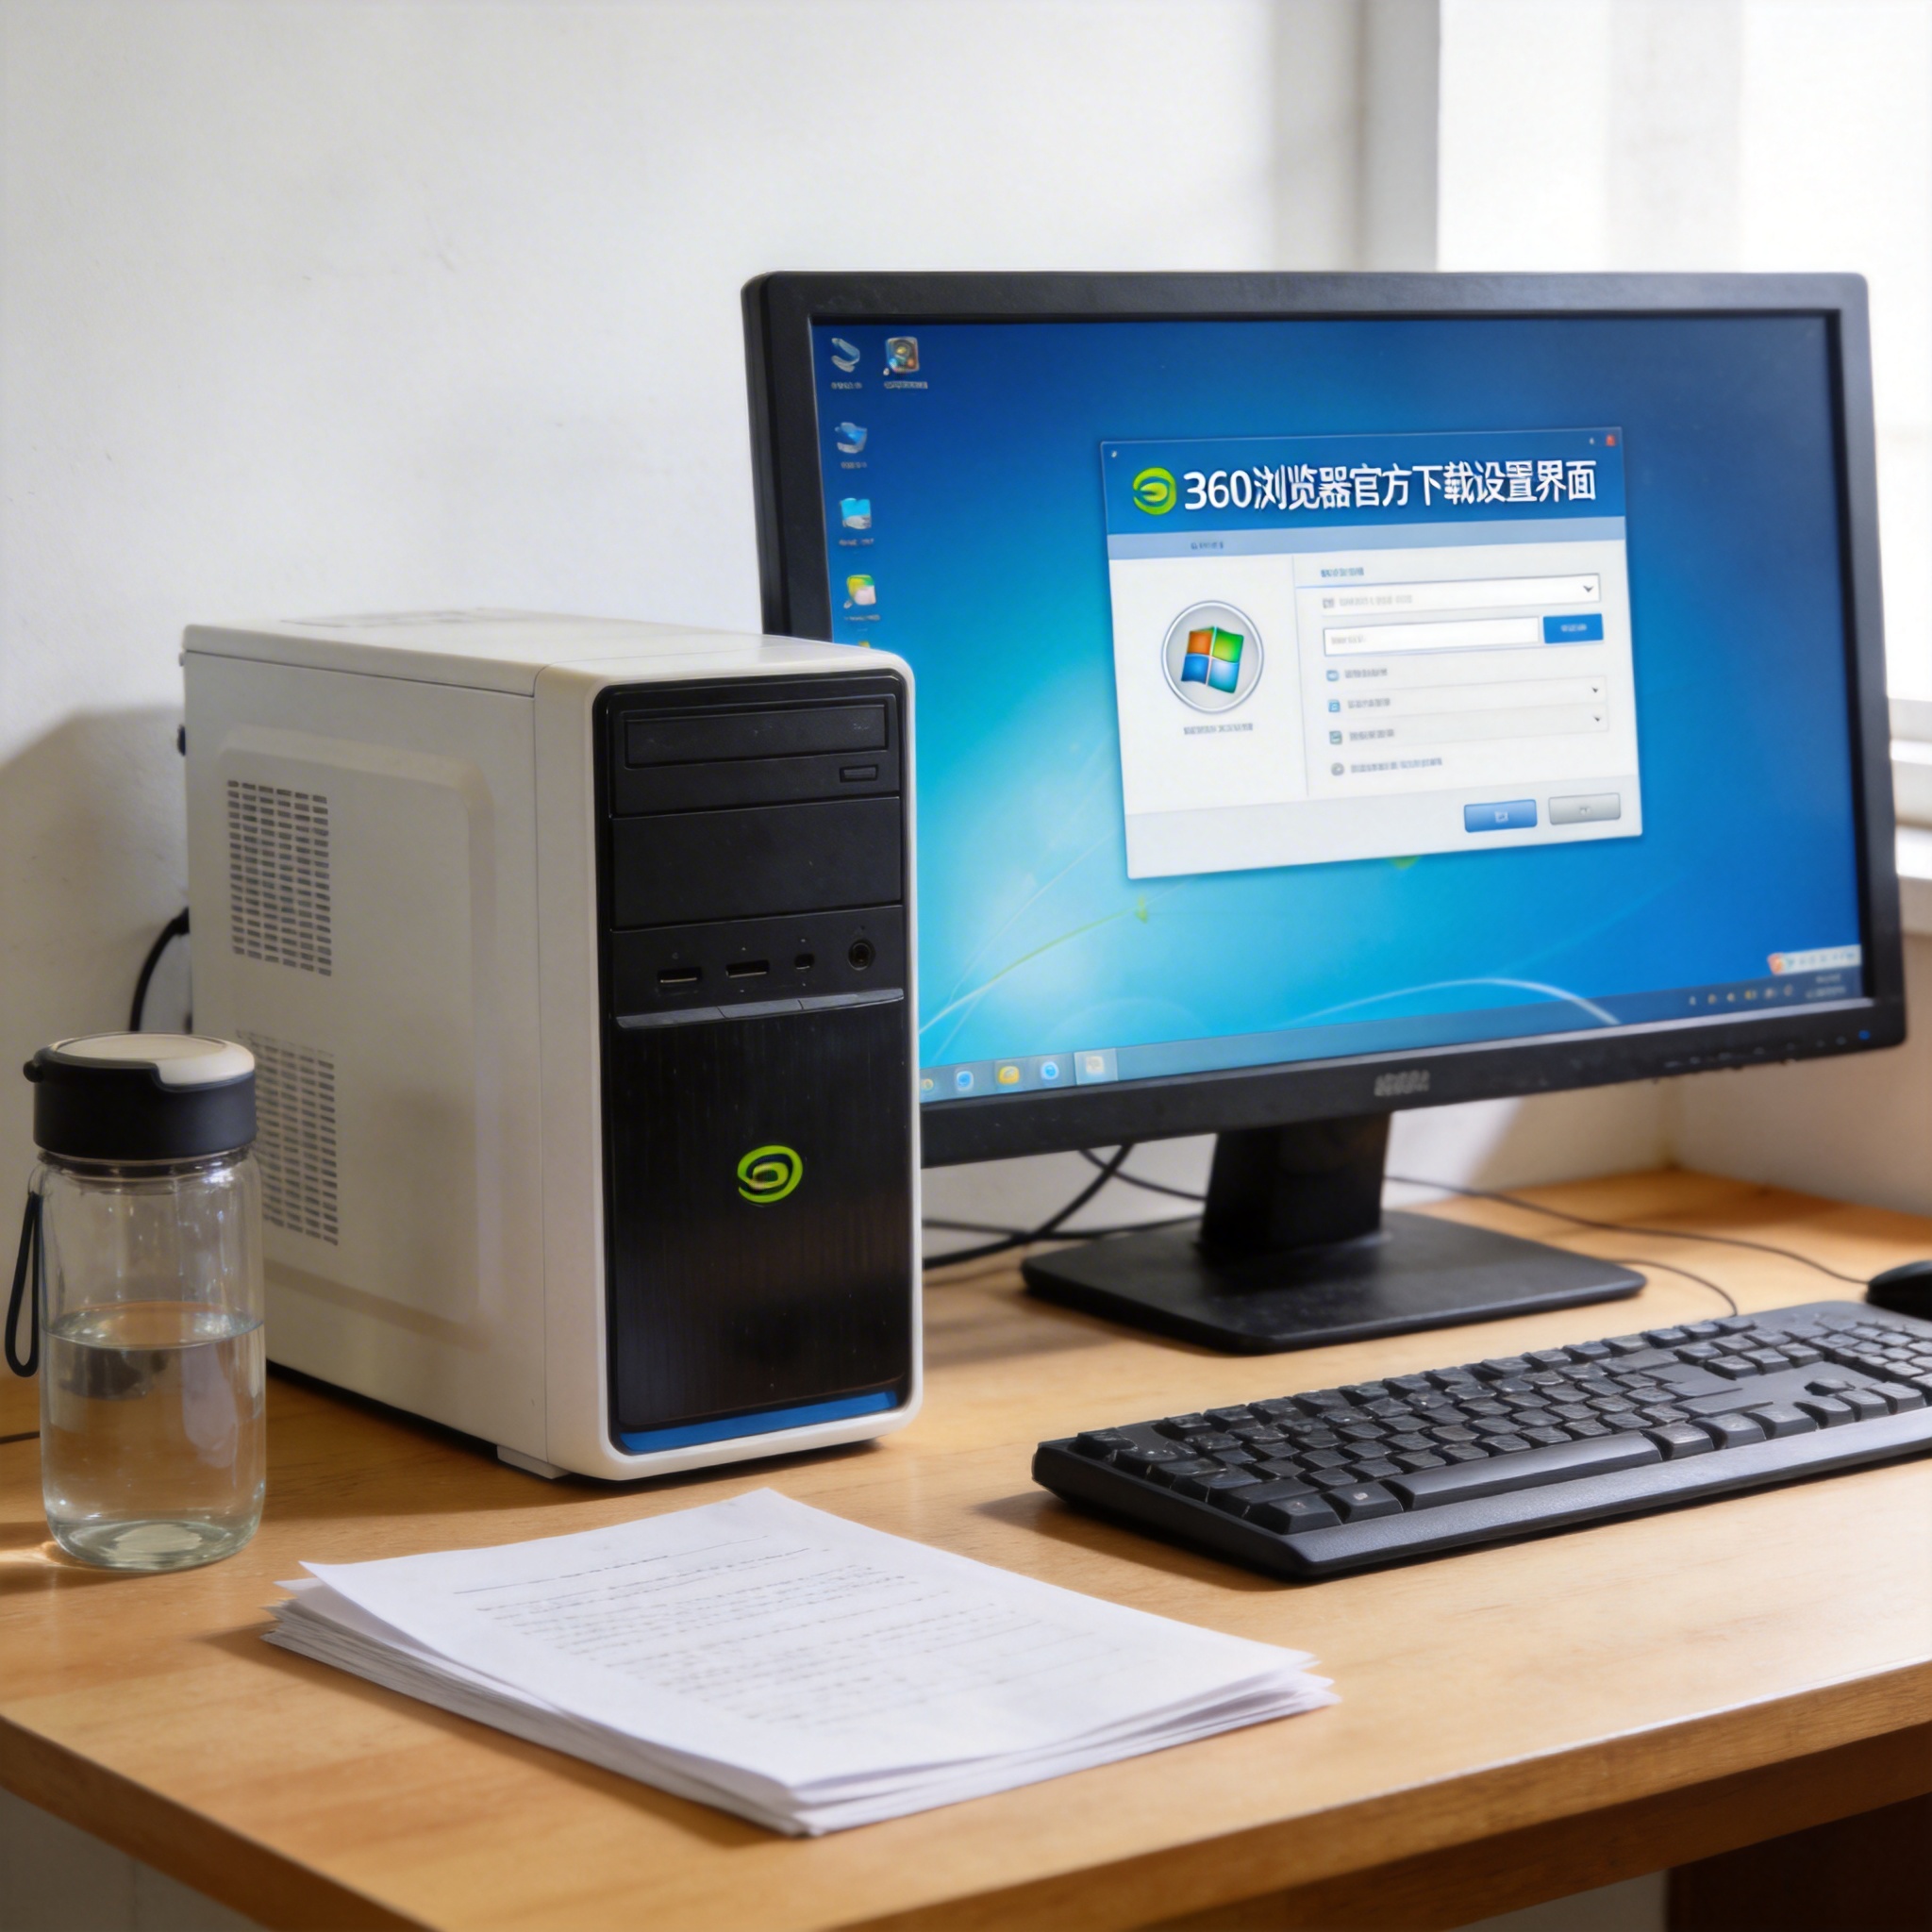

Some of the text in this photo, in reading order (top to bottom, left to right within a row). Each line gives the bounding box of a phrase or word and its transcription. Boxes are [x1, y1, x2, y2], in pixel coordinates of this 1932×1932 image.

[1183, 459, 1596, 510] 360浏览器官方下载设置界面
